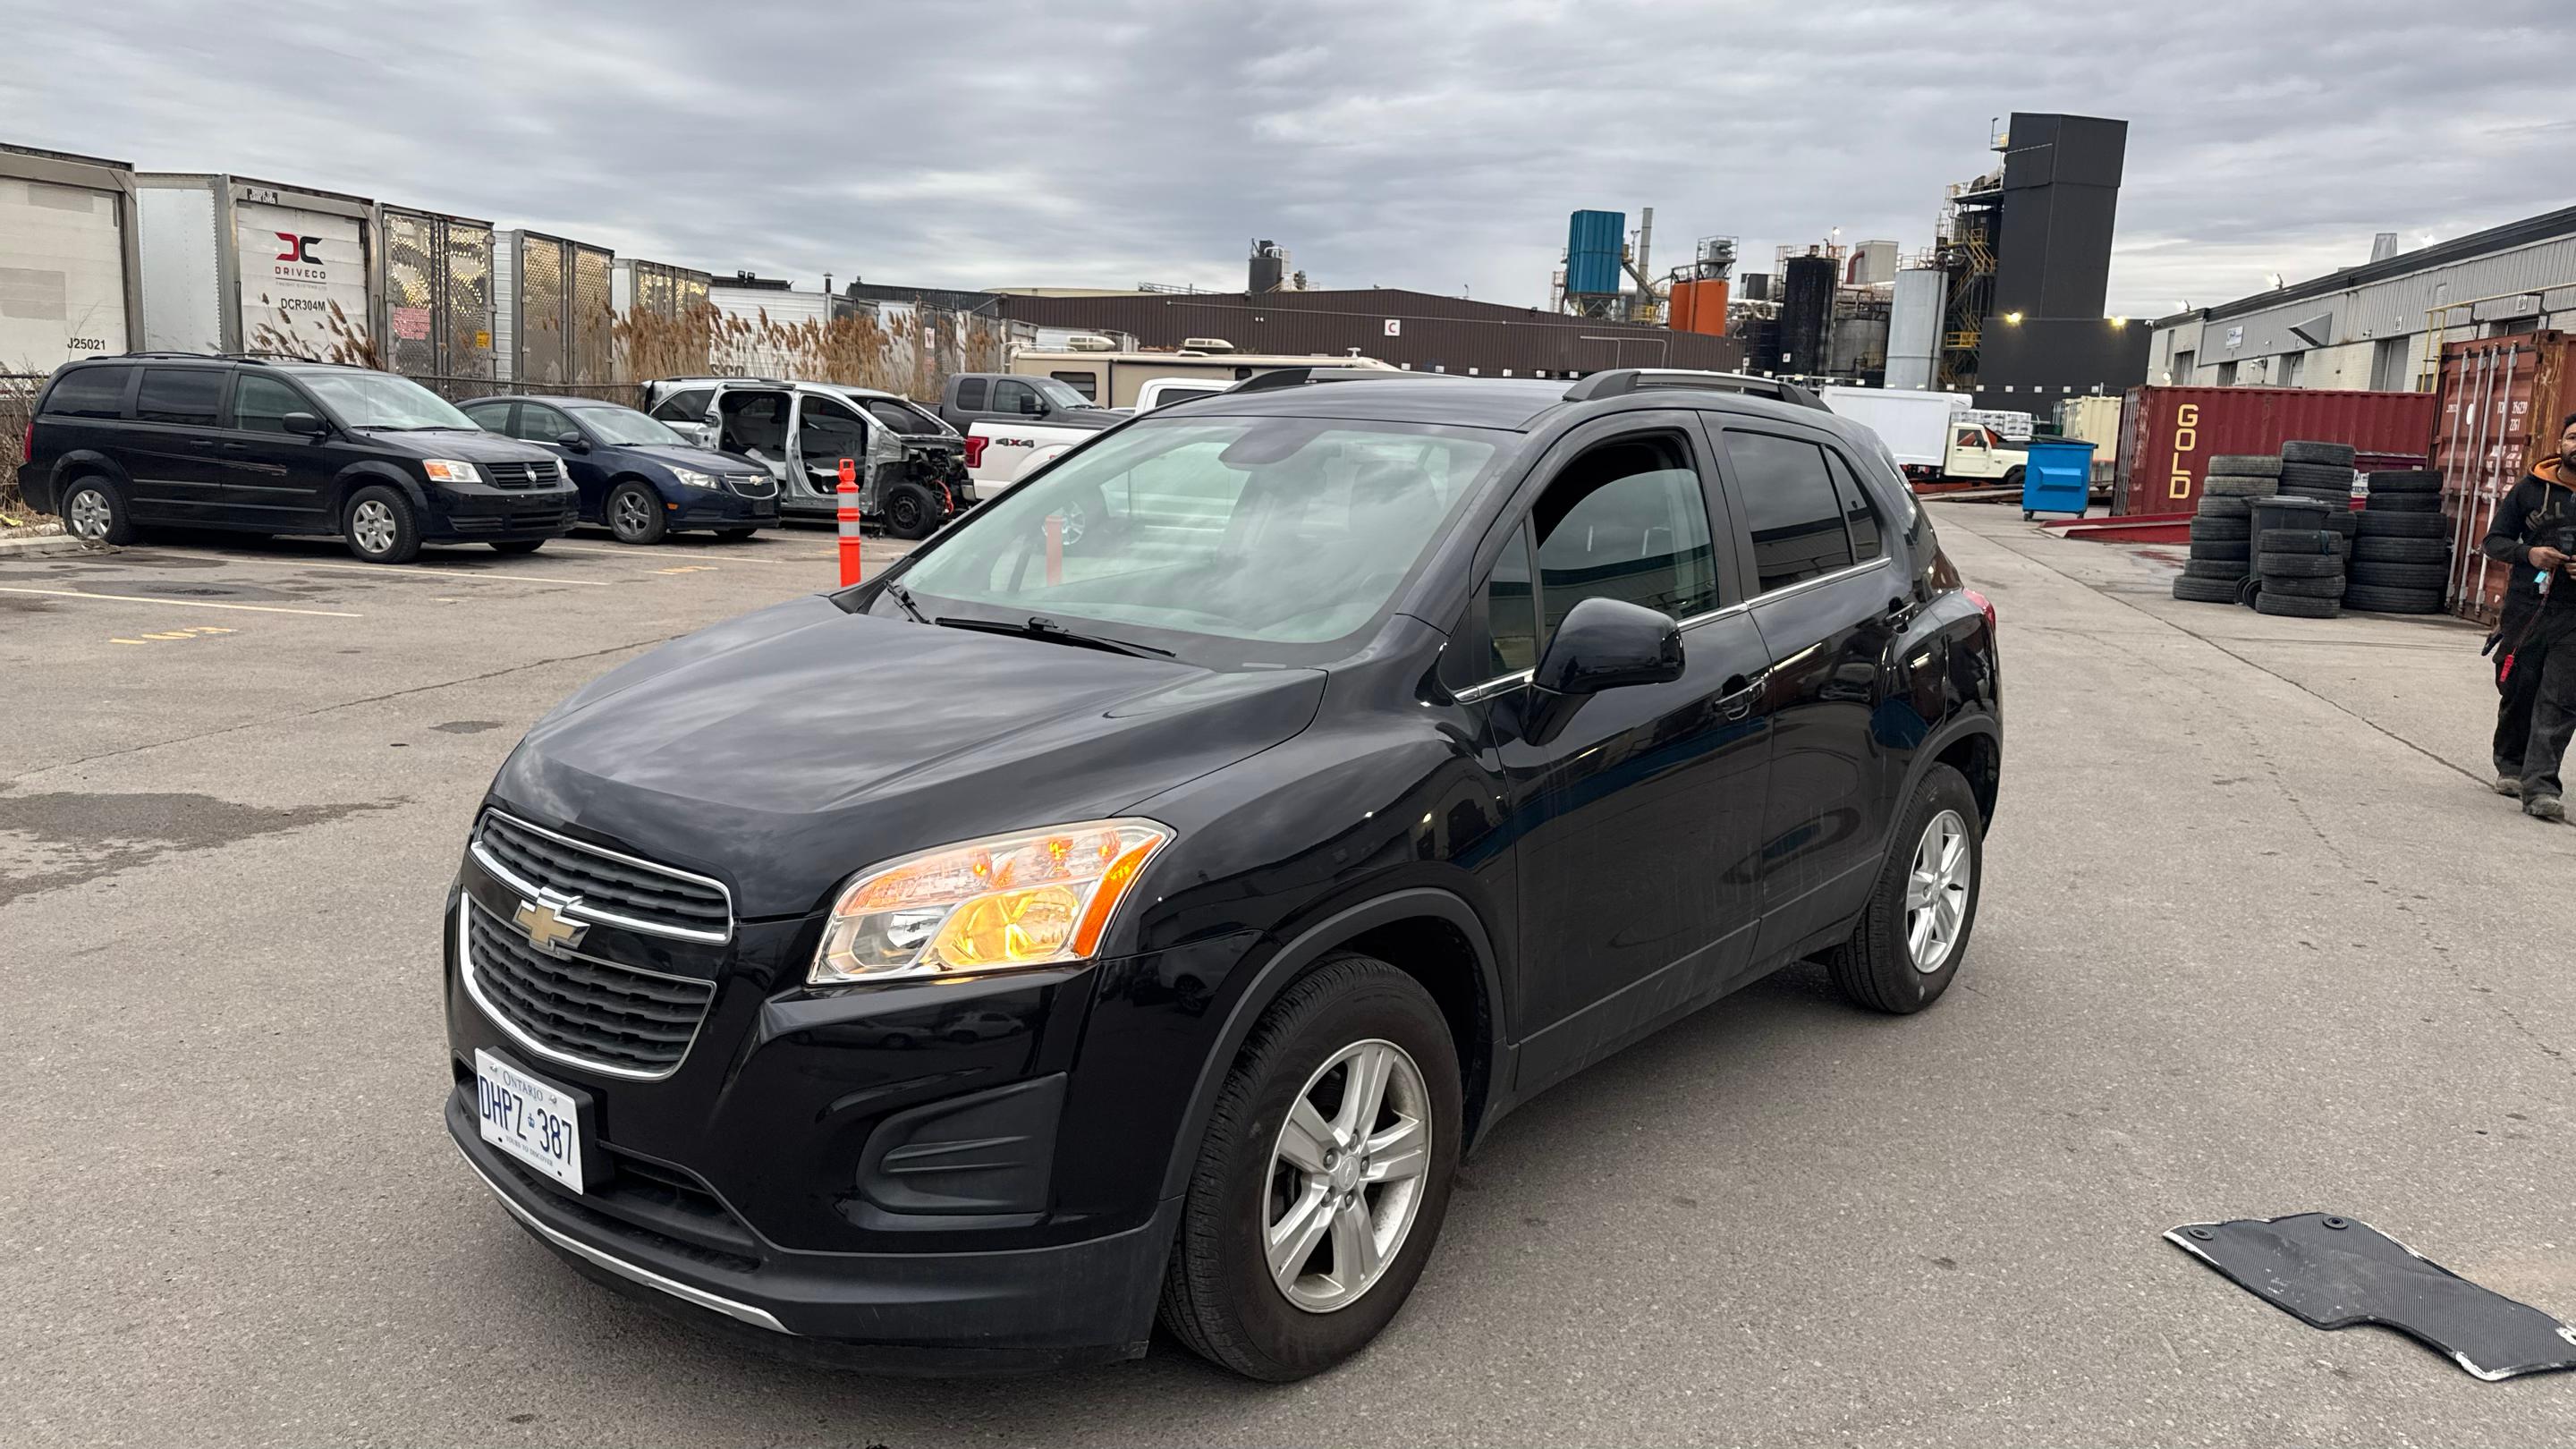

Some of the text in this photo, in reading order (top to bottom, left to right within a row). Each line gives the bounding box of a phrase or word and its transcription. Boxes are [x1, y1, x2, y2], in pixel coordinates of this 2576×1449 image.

[275, 266, 326, 279] DRIVECO
[281, 298, 326, 311] DCR304M
[1388, 322, 1396, 333] C
[67, 337, 106, 350] J25021
[2169, 403, 2199, 499] GOLD
[479, 1074, 572, 1165] DHPZ 387
